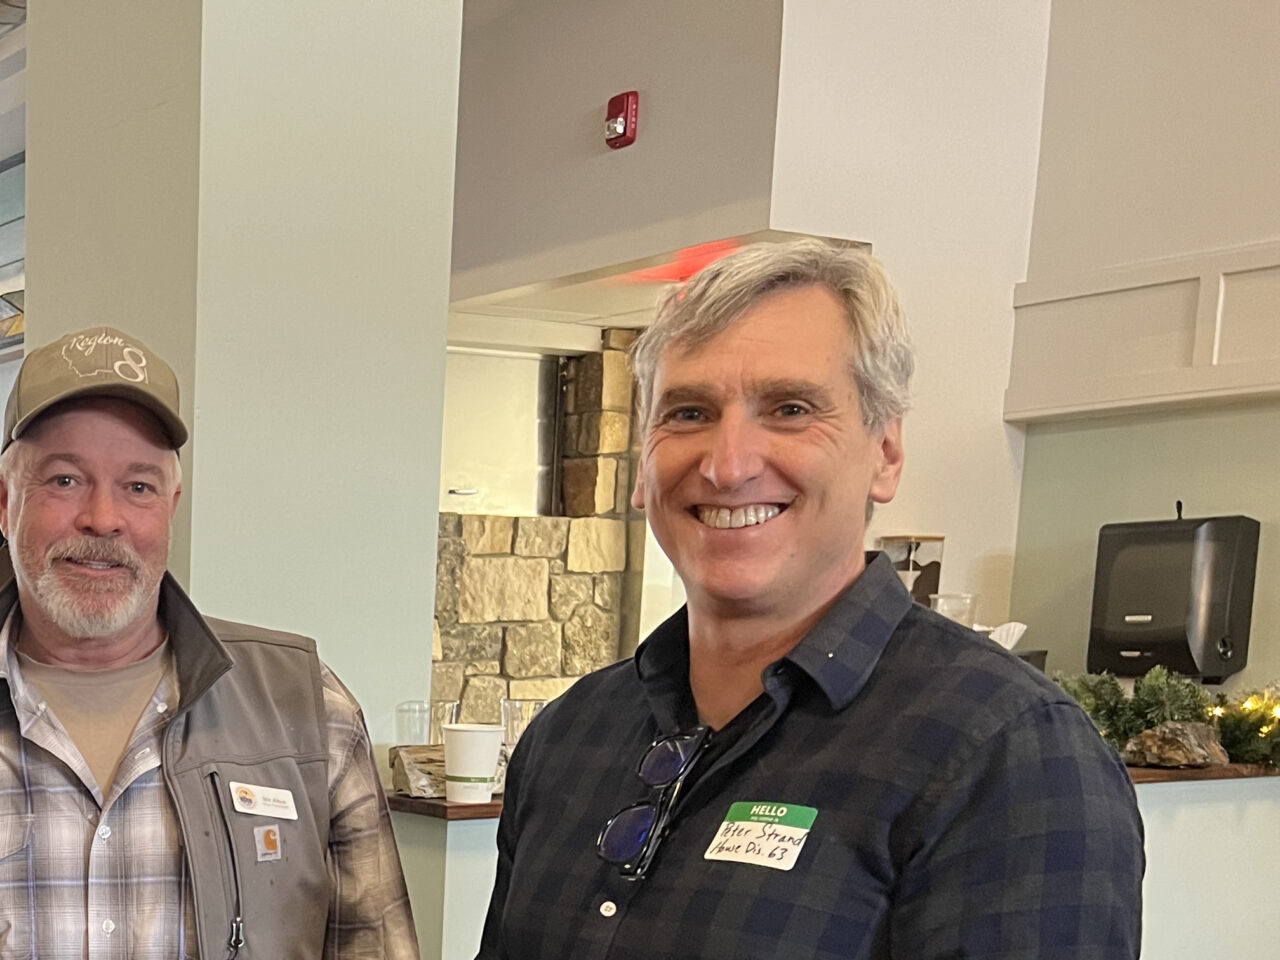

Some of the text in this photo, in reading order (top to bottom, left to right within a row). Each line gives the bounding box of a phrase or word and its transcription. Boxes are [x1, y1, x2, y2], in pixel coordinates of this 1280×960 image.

[70, 331, 146, 382] Region 8
[750, 805, 787, 816] HELLO
[720, 822, 808, 846] Peter Strand
[768, 846, 788, 860] 63
